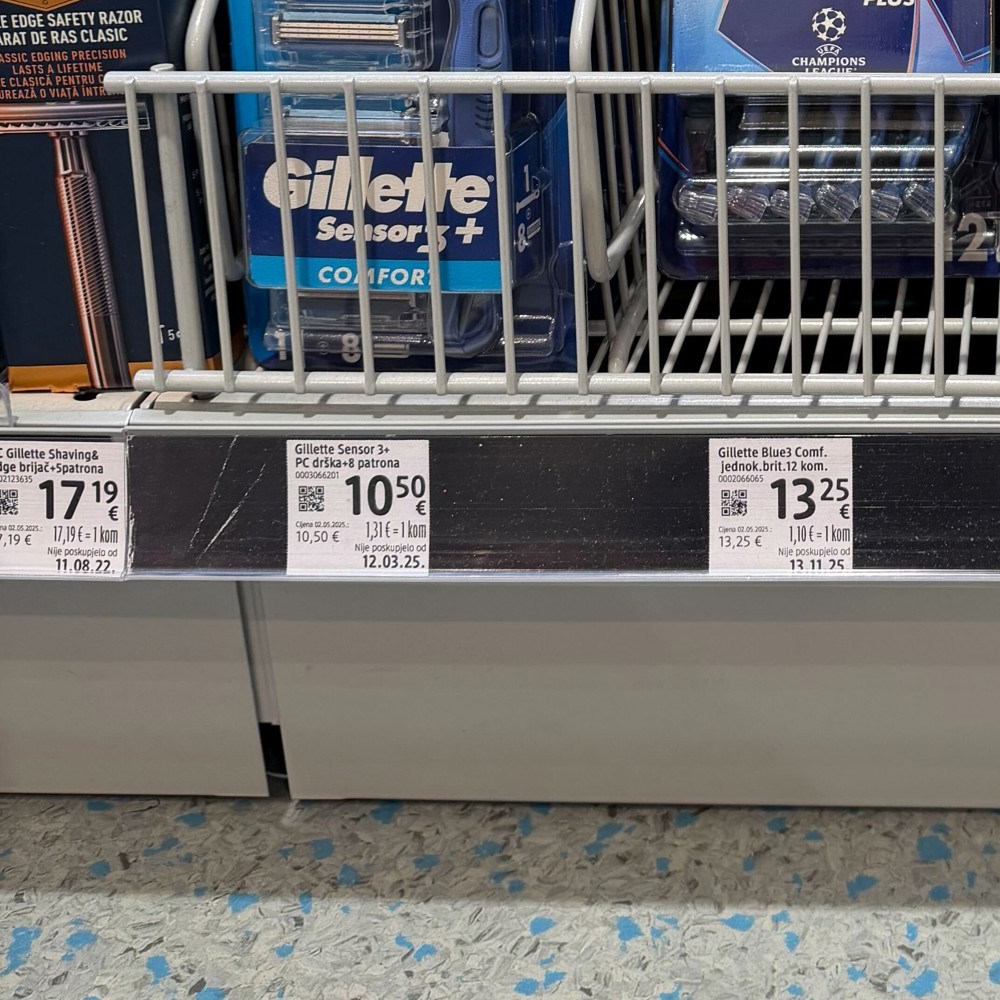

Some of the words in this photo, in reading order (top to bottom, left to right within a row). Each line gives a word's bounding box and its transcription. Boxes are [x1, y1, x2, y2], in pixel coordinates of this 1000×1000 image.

[12, 13, 45, 28] EDGE
[48, 12, 95, 27] SAFETY
[99, 10, 143, 24] RAZOR
[32, 31, 47, 44] DE
[51, 30, 77, 44] RAS
[80, 28, 128, 43] CLASIC
[32, 51, 68, 62] EDGING
[72, 49, 126, 60] PRECISION
[792, 57, 866, 66] CHAMPIONS
[12, 65, 43, 75] LASTS
[48, 64, 54, 74] A
[58, 62, 103, 73] LIFETIME
[56, 75, 95, 86] PENTRU
[263, 155, 490, 215] Gillette
[6, 448, 45, 459] Gillette
[49, 449, 99, 462] Shaving&
[295, 444, 334, 454] Gillette
[338, 444, 374, 454] Sensor
[378, 445, 390, 454] 3+
[718, 447, 758, 458] Gillette
[762, 447, 791, 458] Blue3
[795, 446, 827, 458] Comf.
[296, 458, 309, 468] PC
[313, 457, 354, 468] drška+8
[358, 459, 399, 469] patrona
[801, 461, 828, 471] kom.
[296, 471, 339, 479] 0003066201
[56, 559, 115, 573] 11.08.22.
[363, 555, 425, 568] 12.03.25.
